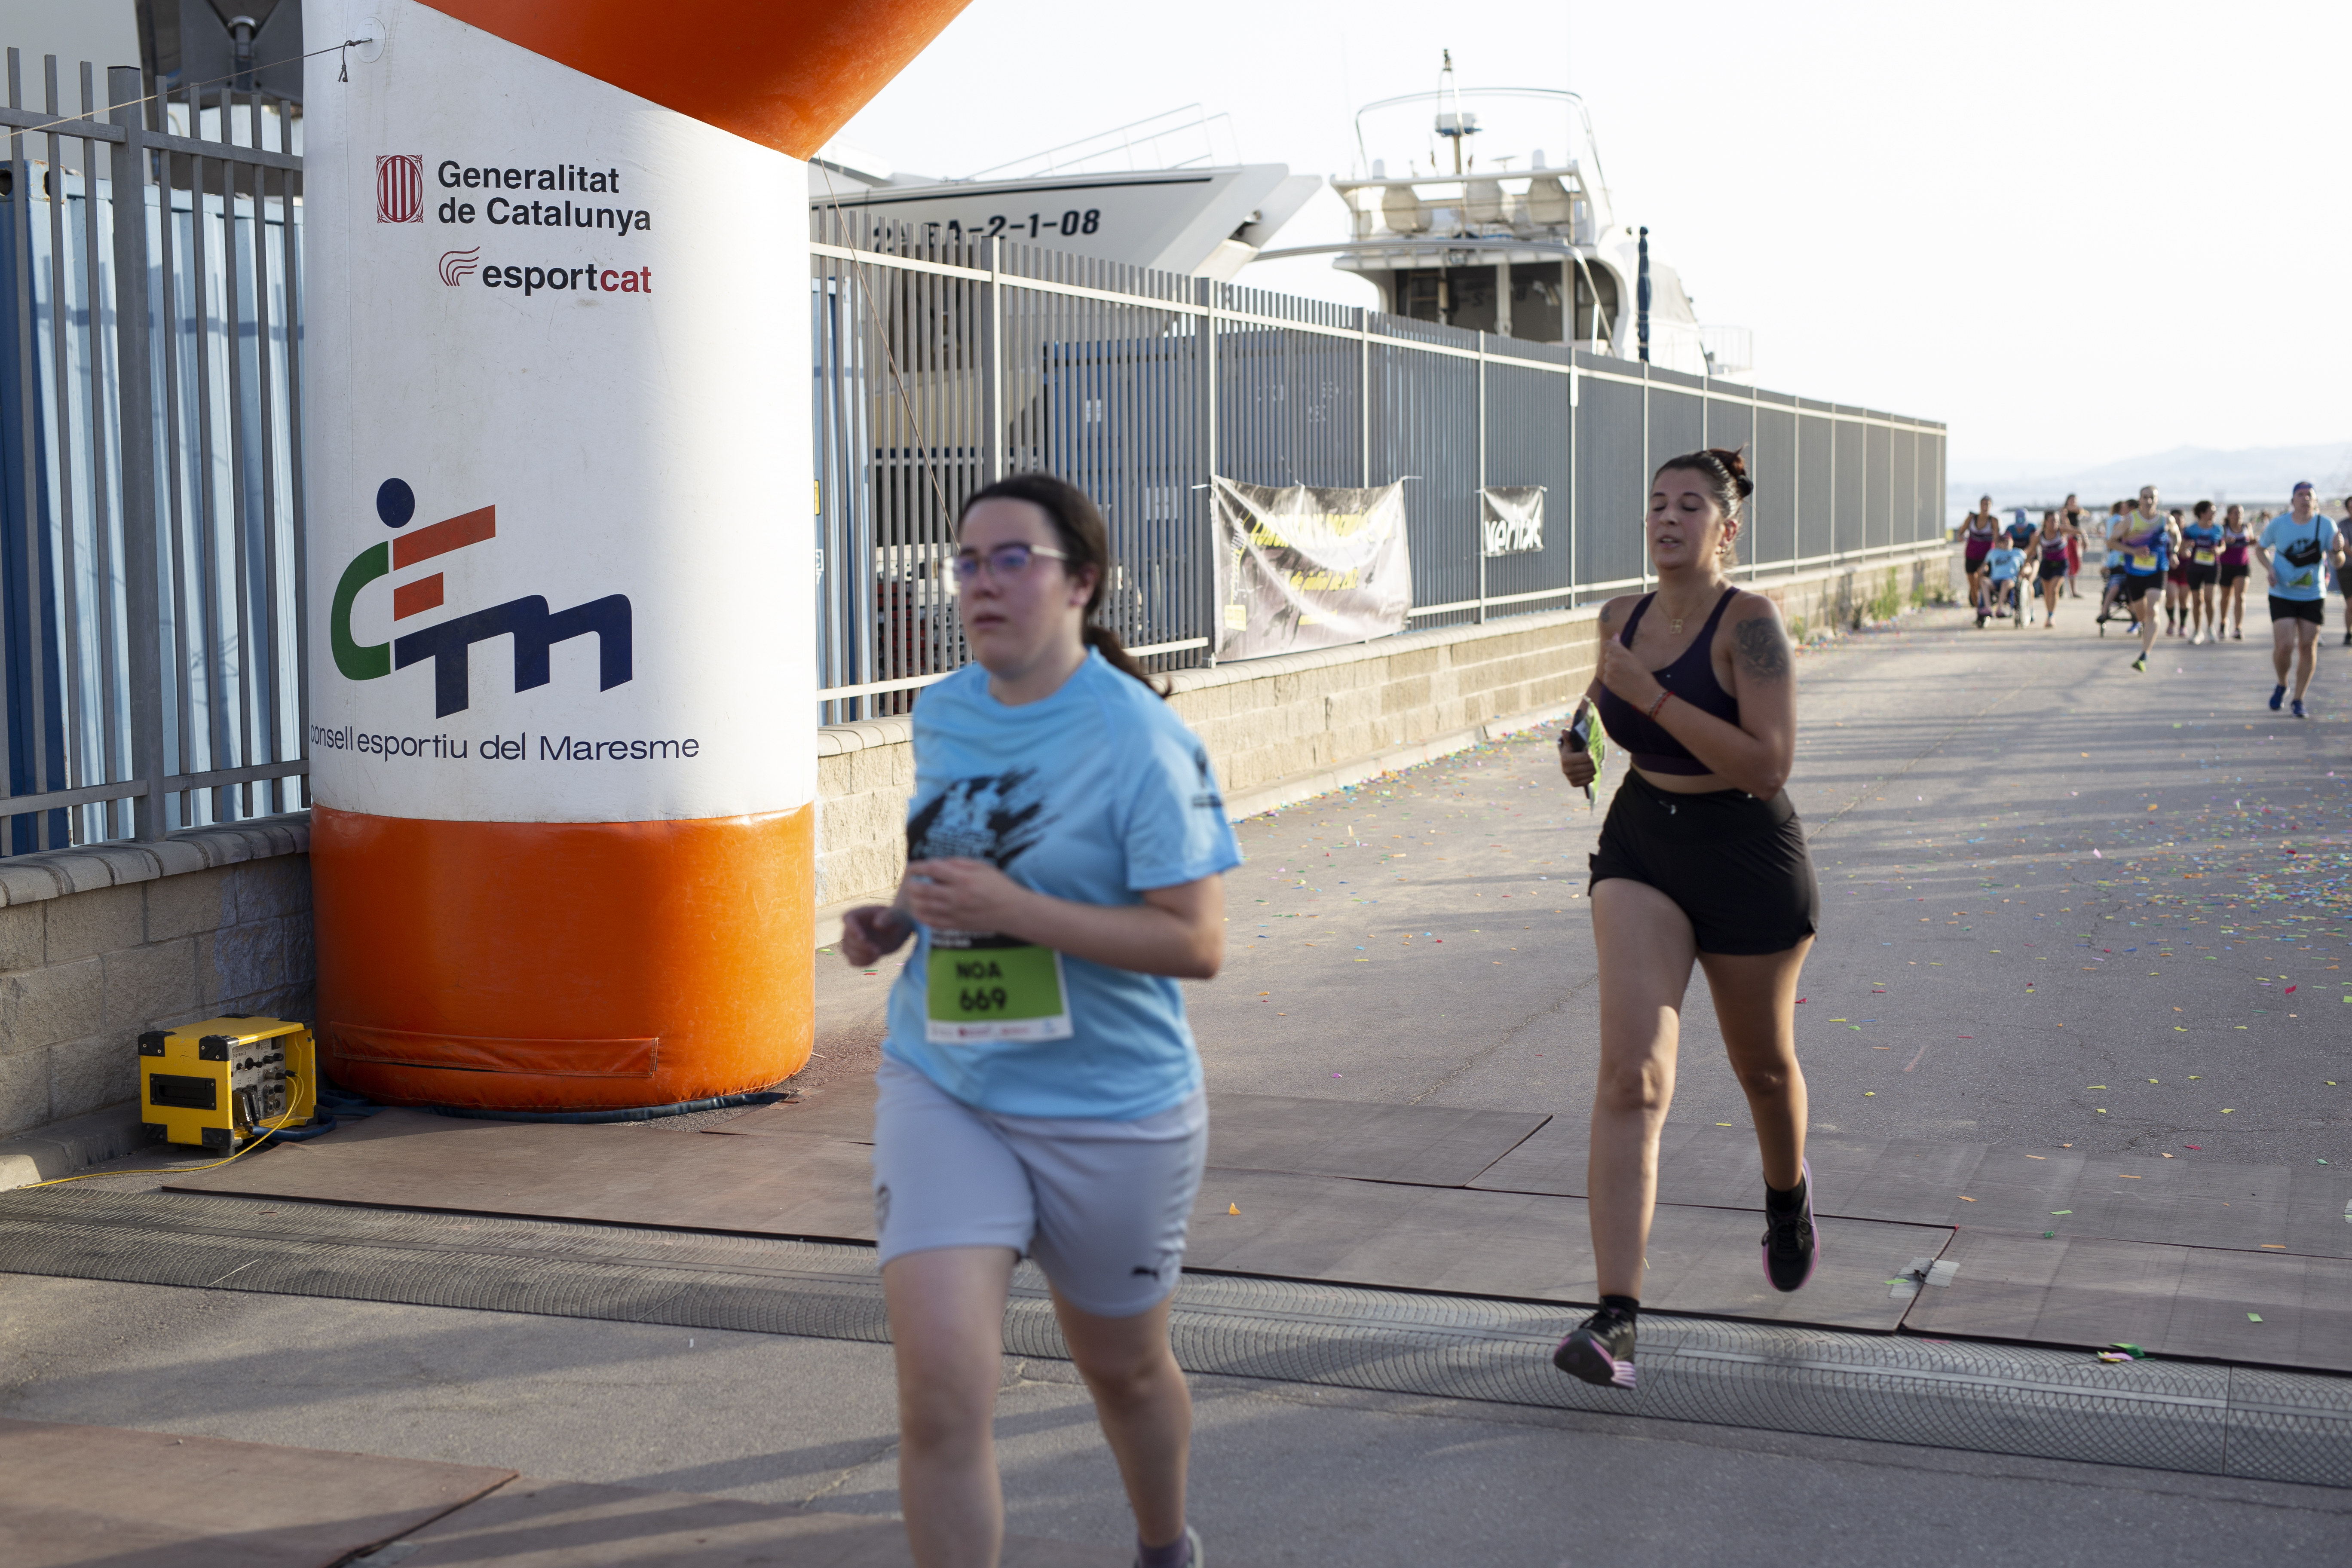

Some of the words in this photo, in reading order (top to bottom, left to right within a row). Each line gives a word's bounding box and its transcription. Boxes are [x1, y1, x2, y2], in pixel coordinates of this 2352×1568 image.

[438, 160, 619, 193] Generalitat
[438, 197, 475, 224] de
[487, 197, 651, 236] Catalunya
[482, 263, 651, 296] esportcat
[310, 723, 353, 751] consell
[357, 733, 467, 763] esportiu
[480, 732, 526, 760] del
[540, 736, 699, 761] Maresme
[956, 962, 1002, 980] NOA
[960, 988, 1007, 1011] 669
